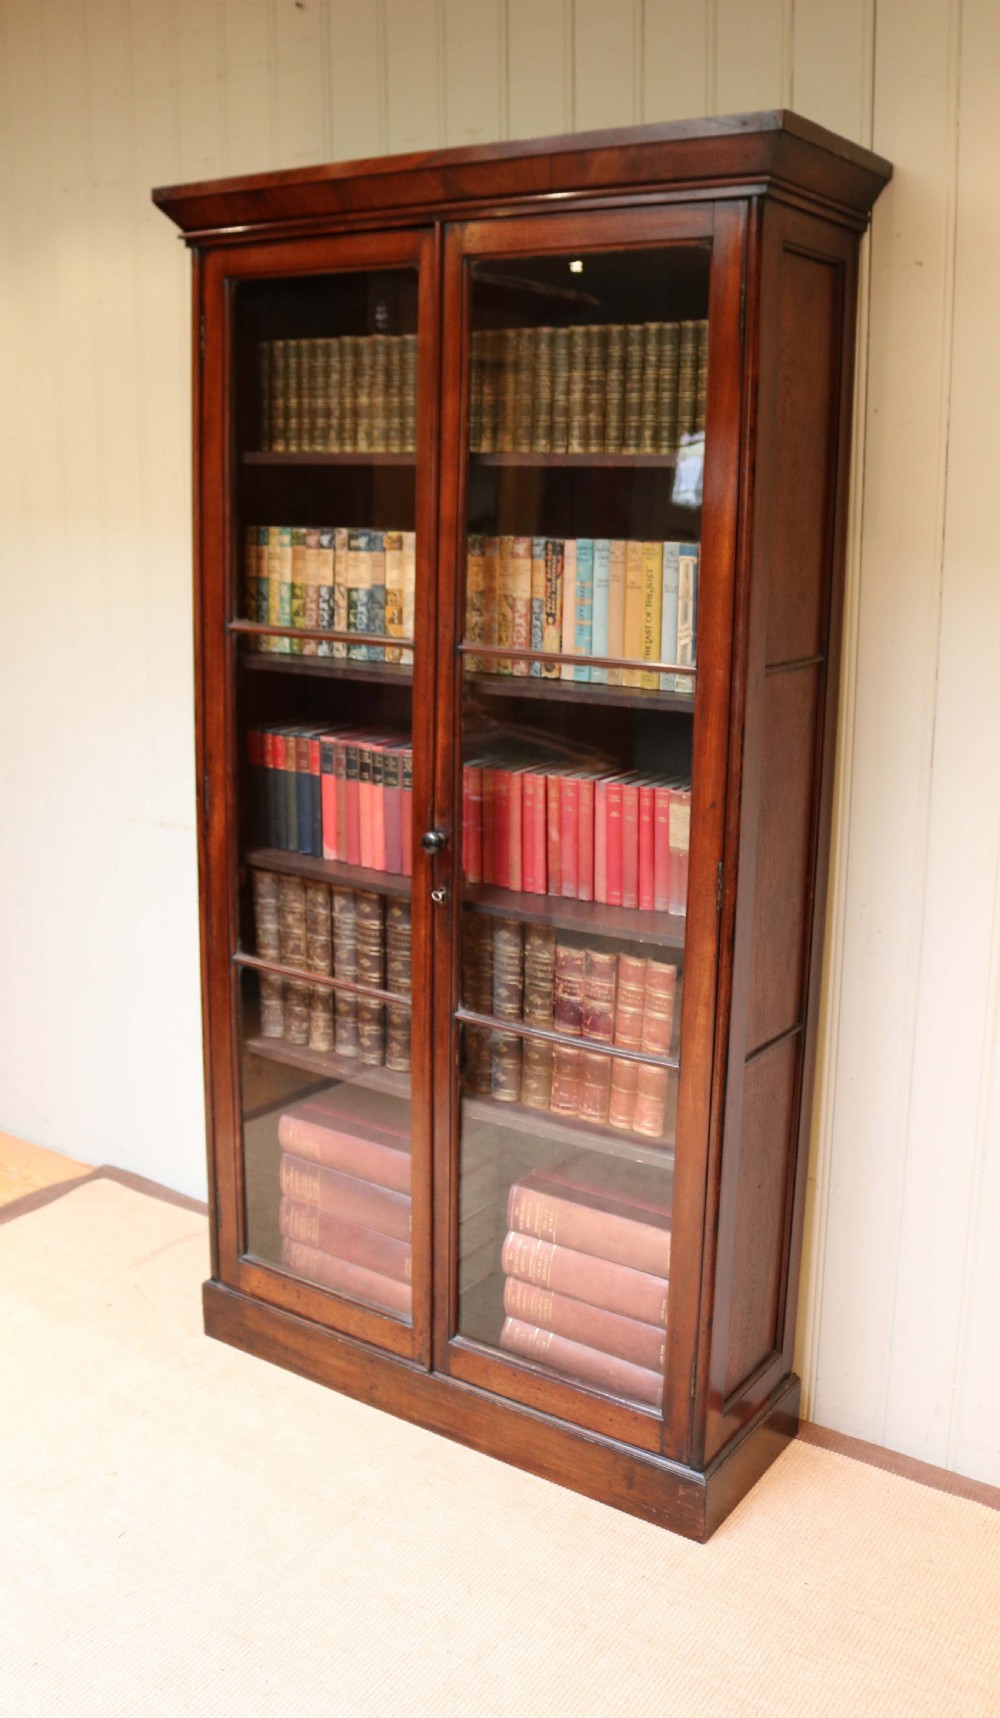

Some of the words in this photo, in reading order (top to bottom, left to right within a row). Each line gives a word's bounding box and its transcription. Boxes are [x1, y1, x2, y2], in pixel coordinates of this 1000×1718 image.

[645, 568, 654, 593] JUST
[644, 592, 653, 608] THE
[644, 612, 652, 623] OF
[643, 625, 653, 644] LAST
[643, 645, 652, 660] THE
